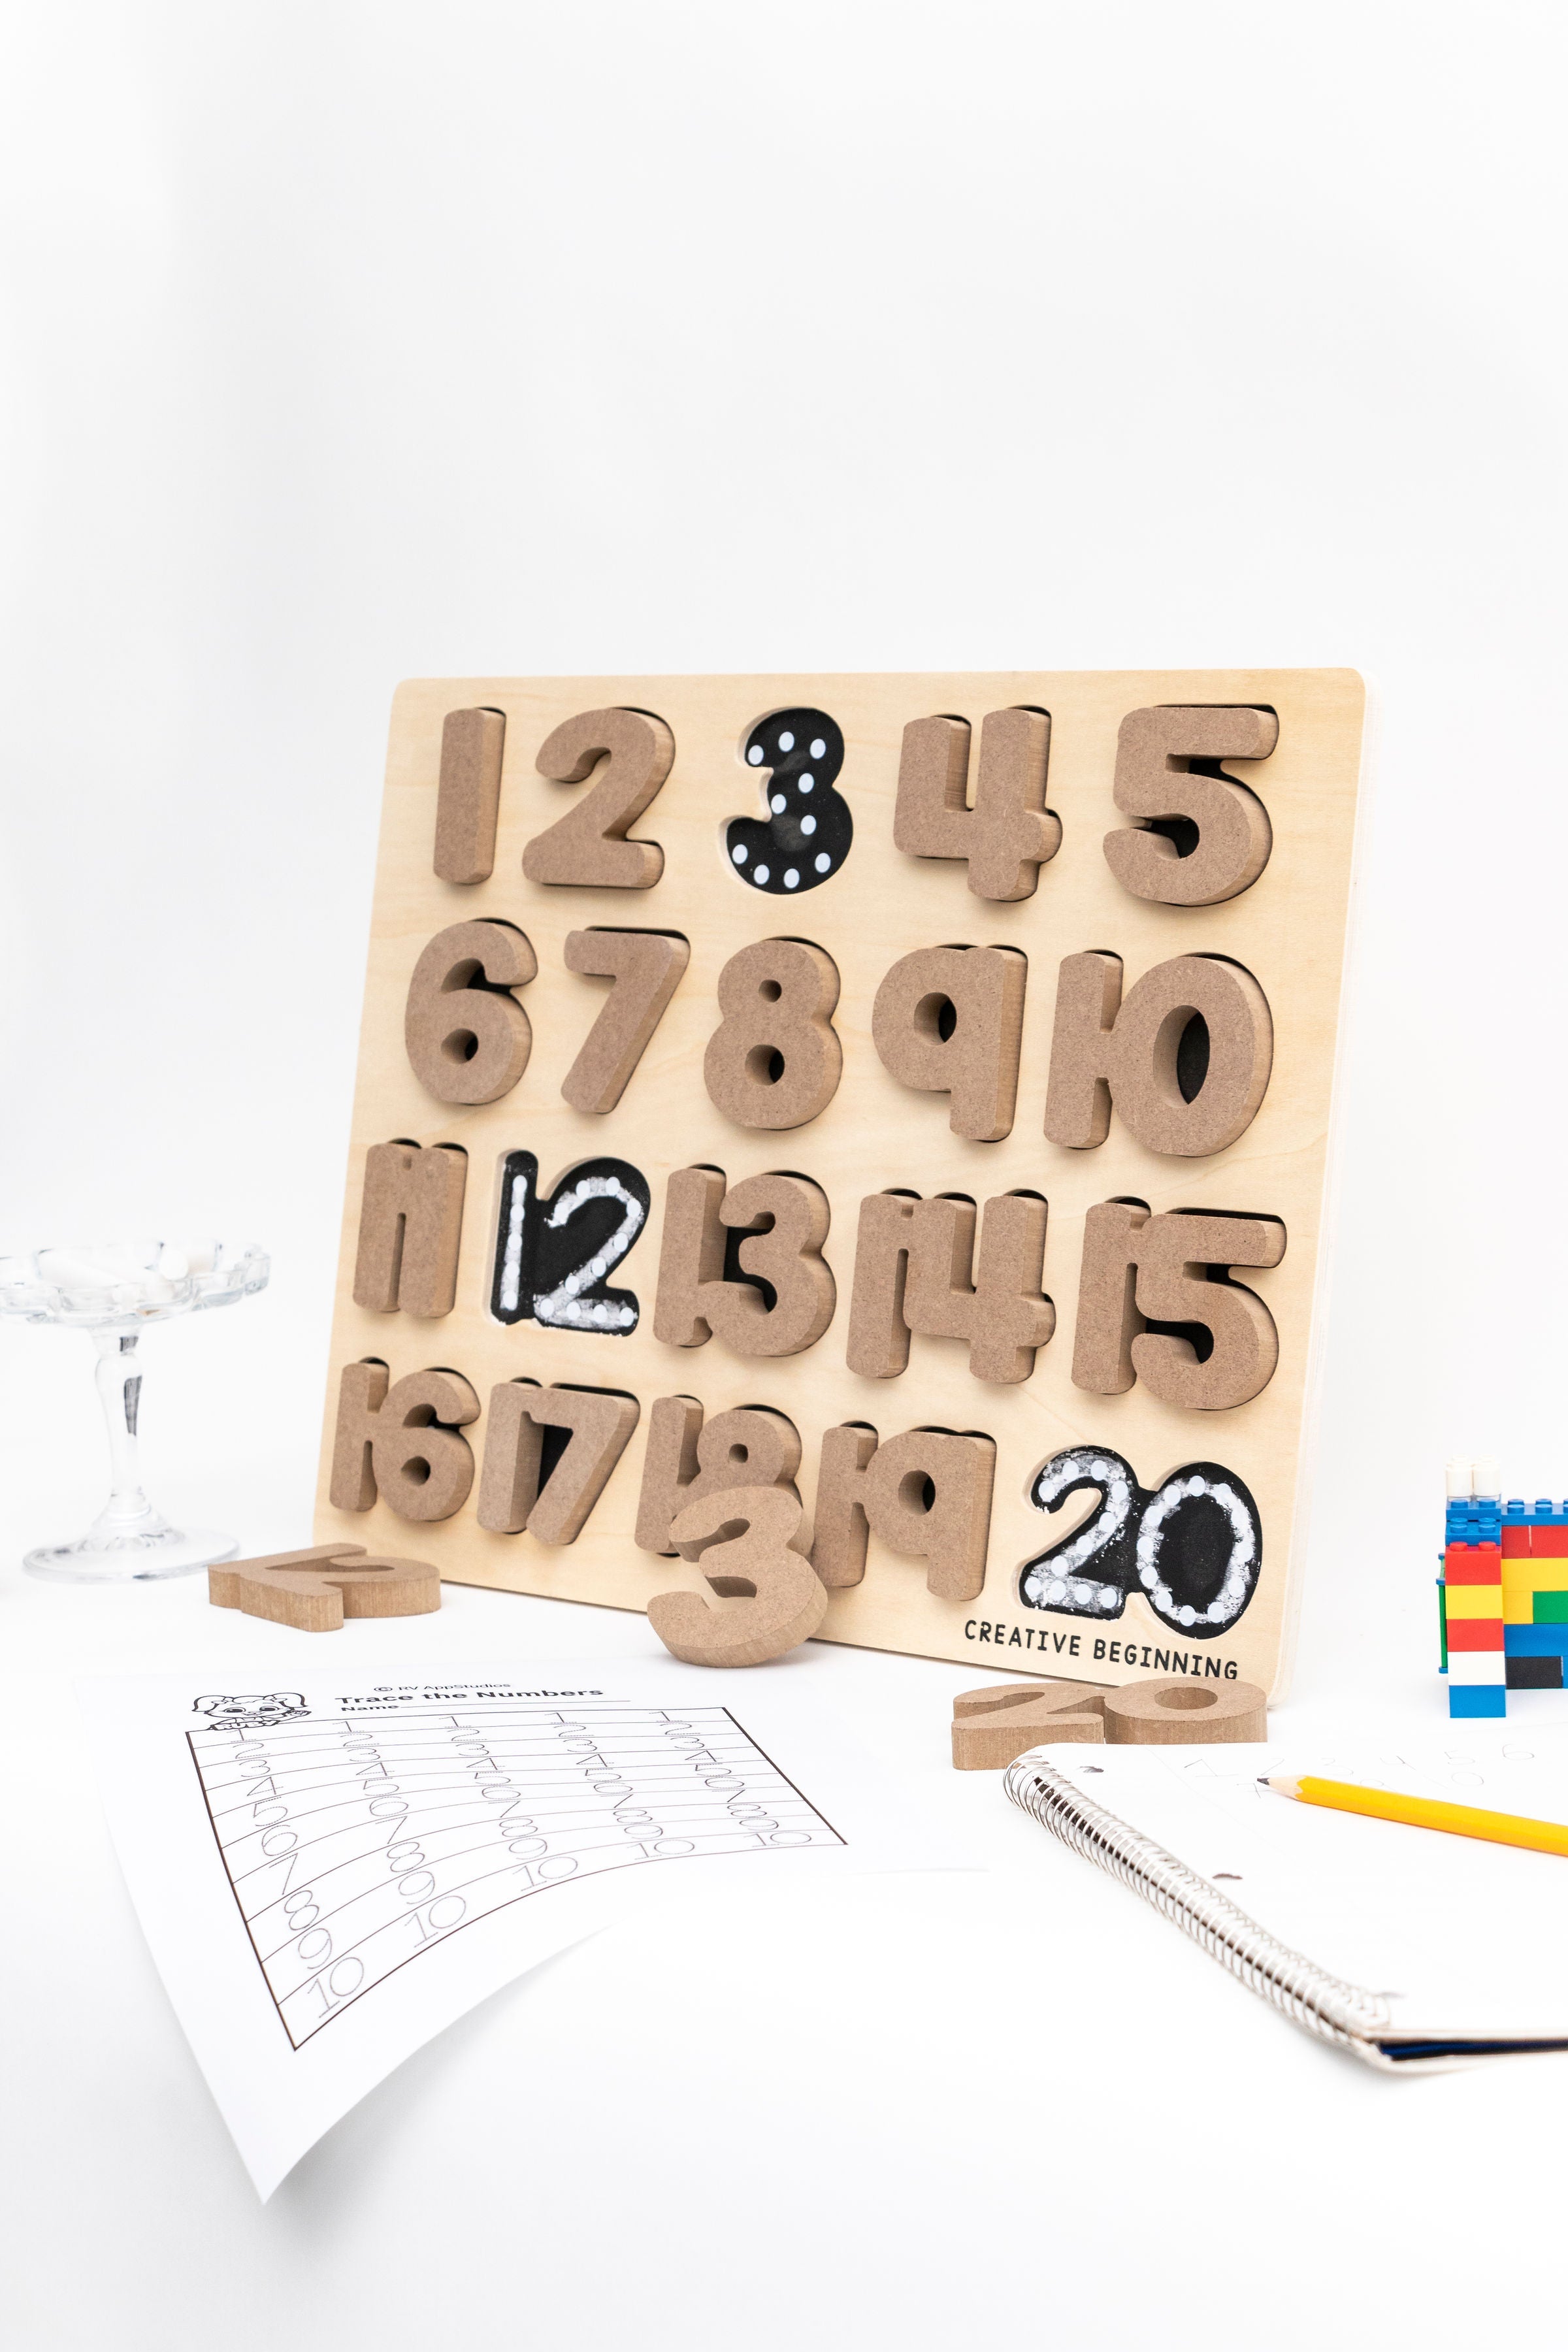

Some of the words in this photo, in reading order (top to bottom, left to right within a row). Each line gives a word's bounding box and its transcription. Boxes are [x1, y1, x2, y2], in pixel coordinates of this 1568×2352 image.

[433, 707, 506, 884] 1
[522, 706, 676, 889] 2
[724, 706, 853, 895] 3
[893, 706, 1063, 902] 4
[1103, 704, 1279, 907] 5
[405, 917, 538, 1105] 6
[561, 925, 691, 1114] 7
[703, 935, 843, 1130] 8
[872, 943, 1028, 1143] 9
[1043, 949, 1273, 1158] 10
[352, 1138, 468, 1318] 11
[490, 1149, 651, 1337] 12
[653, 1164, 836, 1357] 13
[845, 1188, 1056, 1384] 14
[1071, 1195, 1287, 1411] 15
[329, 1356, 482, 1522] 16
[476, 1378, 641, 1546] 17
[813, 1421, 996, 1600] 19
[1019, 1444, 1262, 1640] 20
[647, 1486, 828, 1667] 3
[423, 1682, 511, 1691] AppStudios
[965, 1619, 1081, 1656] CREATIVE
[1094, 1639, 1237, 1680] BEGINNING
[210, 1720, 281, 1731] RUBY
[227, 1729, 257, 1742] 1
[333, 1721, 365, 1733] 1
[438, 1716, 472, 1728] 1
[544, 1712, 577, 1723] 1
[649, 1711, 683, 1722] 1
[336, 1693, 414, 1704] Trace
[422, 1692, 468, 1701] the
[476, 1689, 604, 1699] Numbers
[951, 1677, 1267, 1771] 20
[233, 1742, 270, 1759] 2
[339, 1733, 380, 1747] 2
[446, 1729, 487, 1741] 2
[553, 1725, 595, 1737] 2
[659, 1723, 700, 1735] 2
[239, 1759, 270, 1777] 3
[347, 1748, 380, 1762] 3
[455, 1743, 489, 1756] 3
[563, 1739, 597, 1752] 3
[670, 1737, 704, 1749] 3
[247, 1776, 284, 1797] 4
[355, 1762, 395, 1776] 4
[466, 1757, 506, 1770] 4
[576, 1754, 614, 1767] 4
[684, 1750, 723, 1762] 4
[1443, 1750, 1476, 1765] 5
[1502, 1743, 1535, 1761] 6
[253, 1796, 288, 1827] 5
[363, 1777, 399, 1797] 5
[474, 1771, 511, 1785] 5
[585, 1768, 621, 1782] 5
[695, 1763, 732, 1776] 5
[261, 1825, 298, 1856] 6
[369, 1796, 409, 1817] 6
[482, 1786, 521, 1799] 6
[593, 1782, 633, 1794] 6
[705, 1776, 745, 1789] 6
[269, 1853, 298, 1895] 7
[375, 1816, 408, 1844] 7
[488, 1800, 521, 1818] 7
[600, 1794, 634, 1808] 7
[711, 1789, 746, 1803] 7
[284, 1890, 319, 1931] 8
[387, 1842, 425, 1872] 8
[499, 1818, 538, 1837] 8
[613, 1809, 653, 1823] 8
[727, 1804, 767, 1818] 8
[298, 1928, 332, 1969] 9
[399, 1870, 435, 1904] 9
[509, 1838, 547, 1860] 9
[624, 1825, 662, 1839] 9
[739, 1818, 779, 1831] 9
[307, 1957, 364, 2018] 10
[404, 1895, 466, 1948] 10
[512, 1856, 578, 1891] 10
[627, 1839, 694, 1860] 10
[743, 1831, 811, 1848] 10
